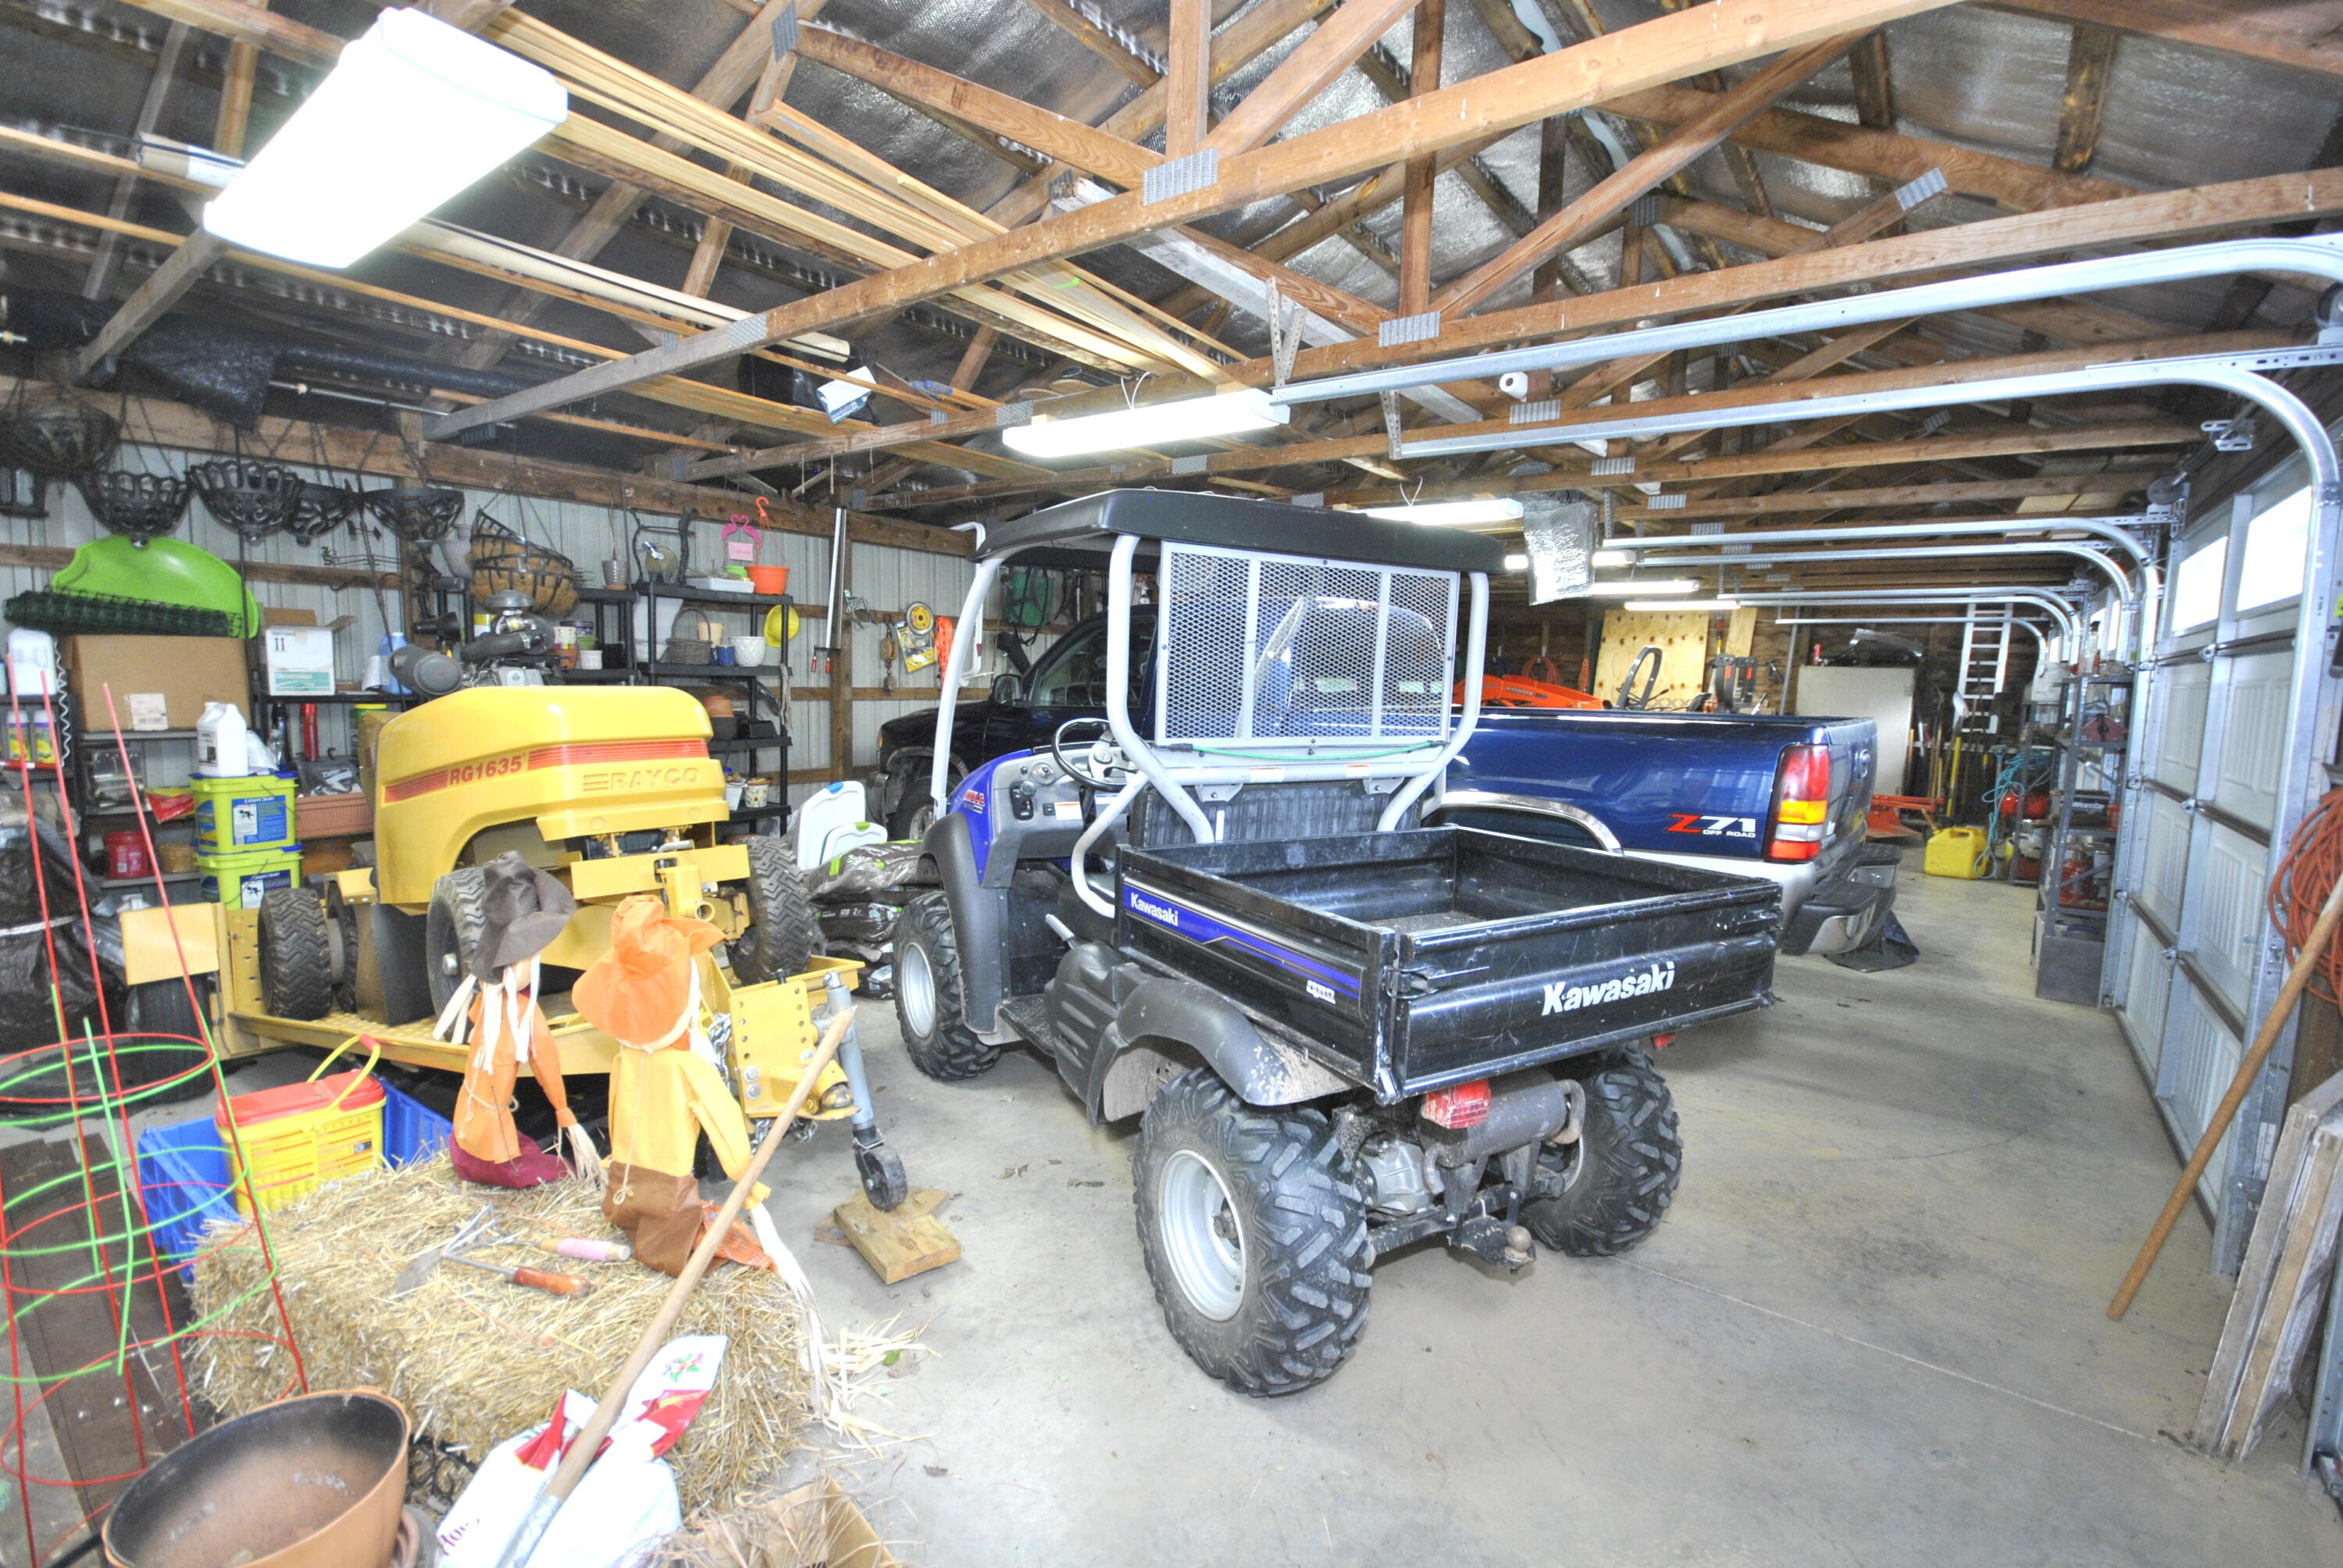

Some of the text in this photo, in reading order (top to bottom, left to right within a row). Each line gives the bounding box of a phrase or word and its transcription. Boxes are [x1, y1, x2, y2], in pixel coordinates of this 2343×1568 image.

[449, 755, 522, 786] RG1635
[610, 767, 700, 790] RAYCO
[1664, 814, 1756, 833] Z71
[1130, 892, 1179, 927] Kawasaki
[1542, 961, 1675, 1016] Kawasaki
